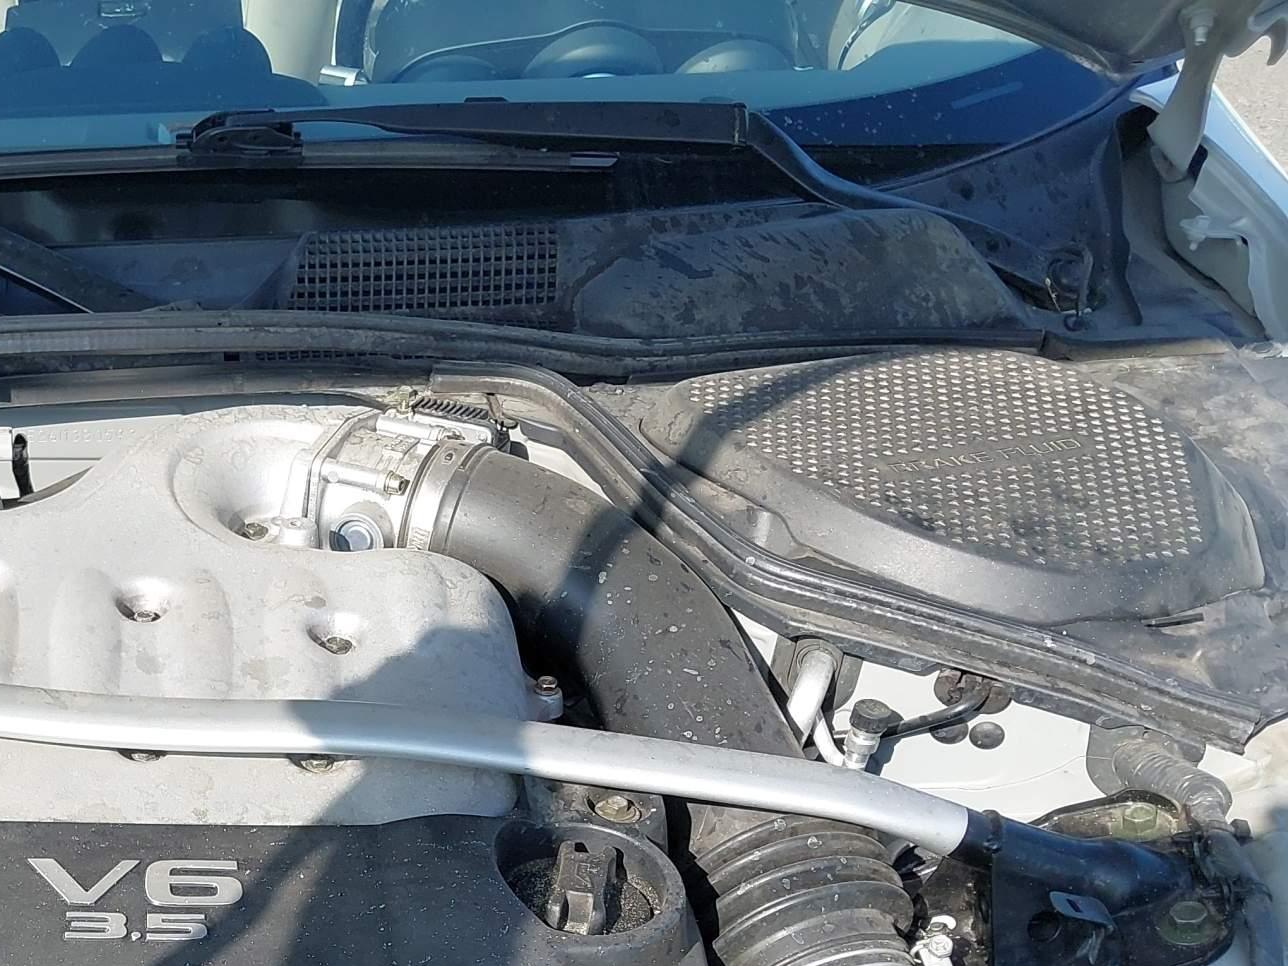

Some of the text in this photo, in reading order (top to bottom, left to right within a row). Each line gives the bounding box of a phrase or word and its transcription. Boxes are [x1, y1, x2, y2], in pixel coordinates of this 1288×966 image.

[888, 438, 1081, 473] BRAKE FLUID
[27, 857, 244, 907] V6
[63, 911, 208, 942] 3.5
